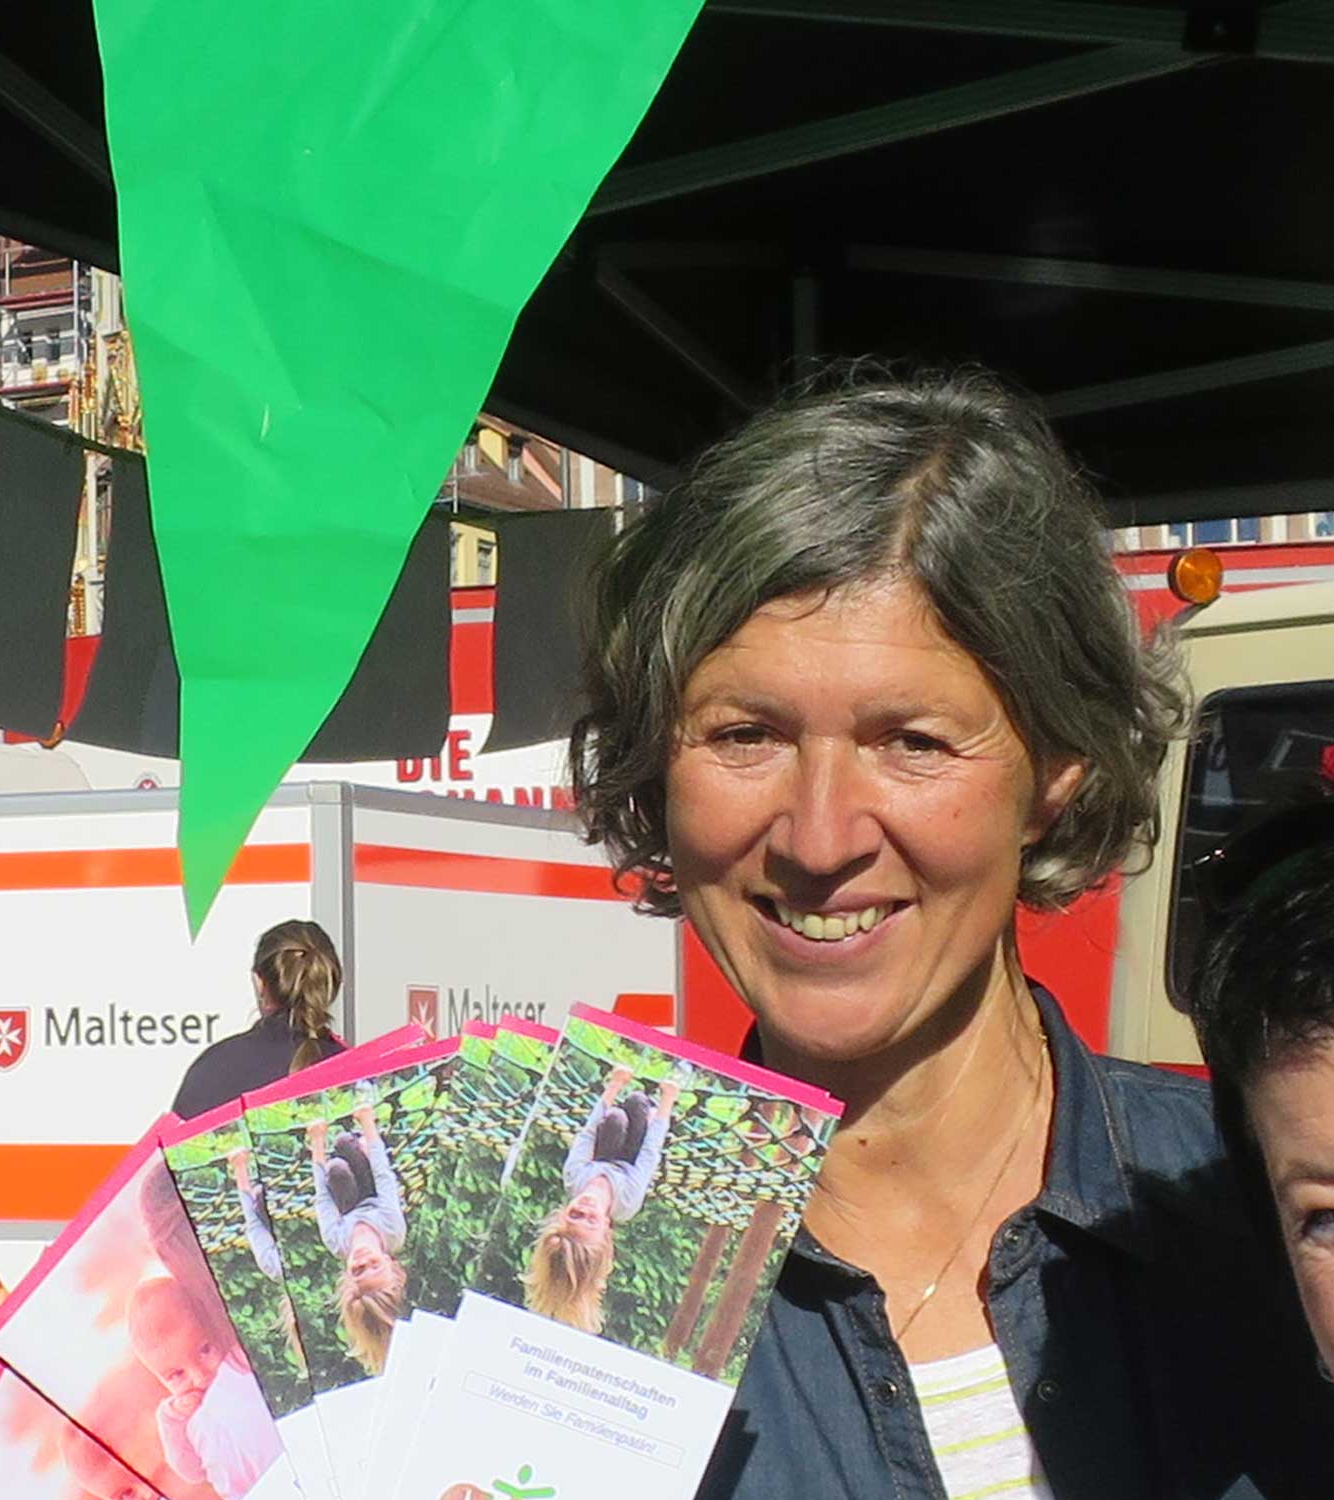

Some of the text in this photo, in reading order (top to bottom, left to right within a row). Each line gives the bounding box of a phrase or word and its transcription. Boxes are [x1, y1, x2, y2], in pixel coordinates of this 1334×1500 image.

[44, 1002, 220, 1047] Malteser
[509, 1335, 677, 1409] Familienpatenschaften
[523, 1361, 650, 1421] im Familienalltag
